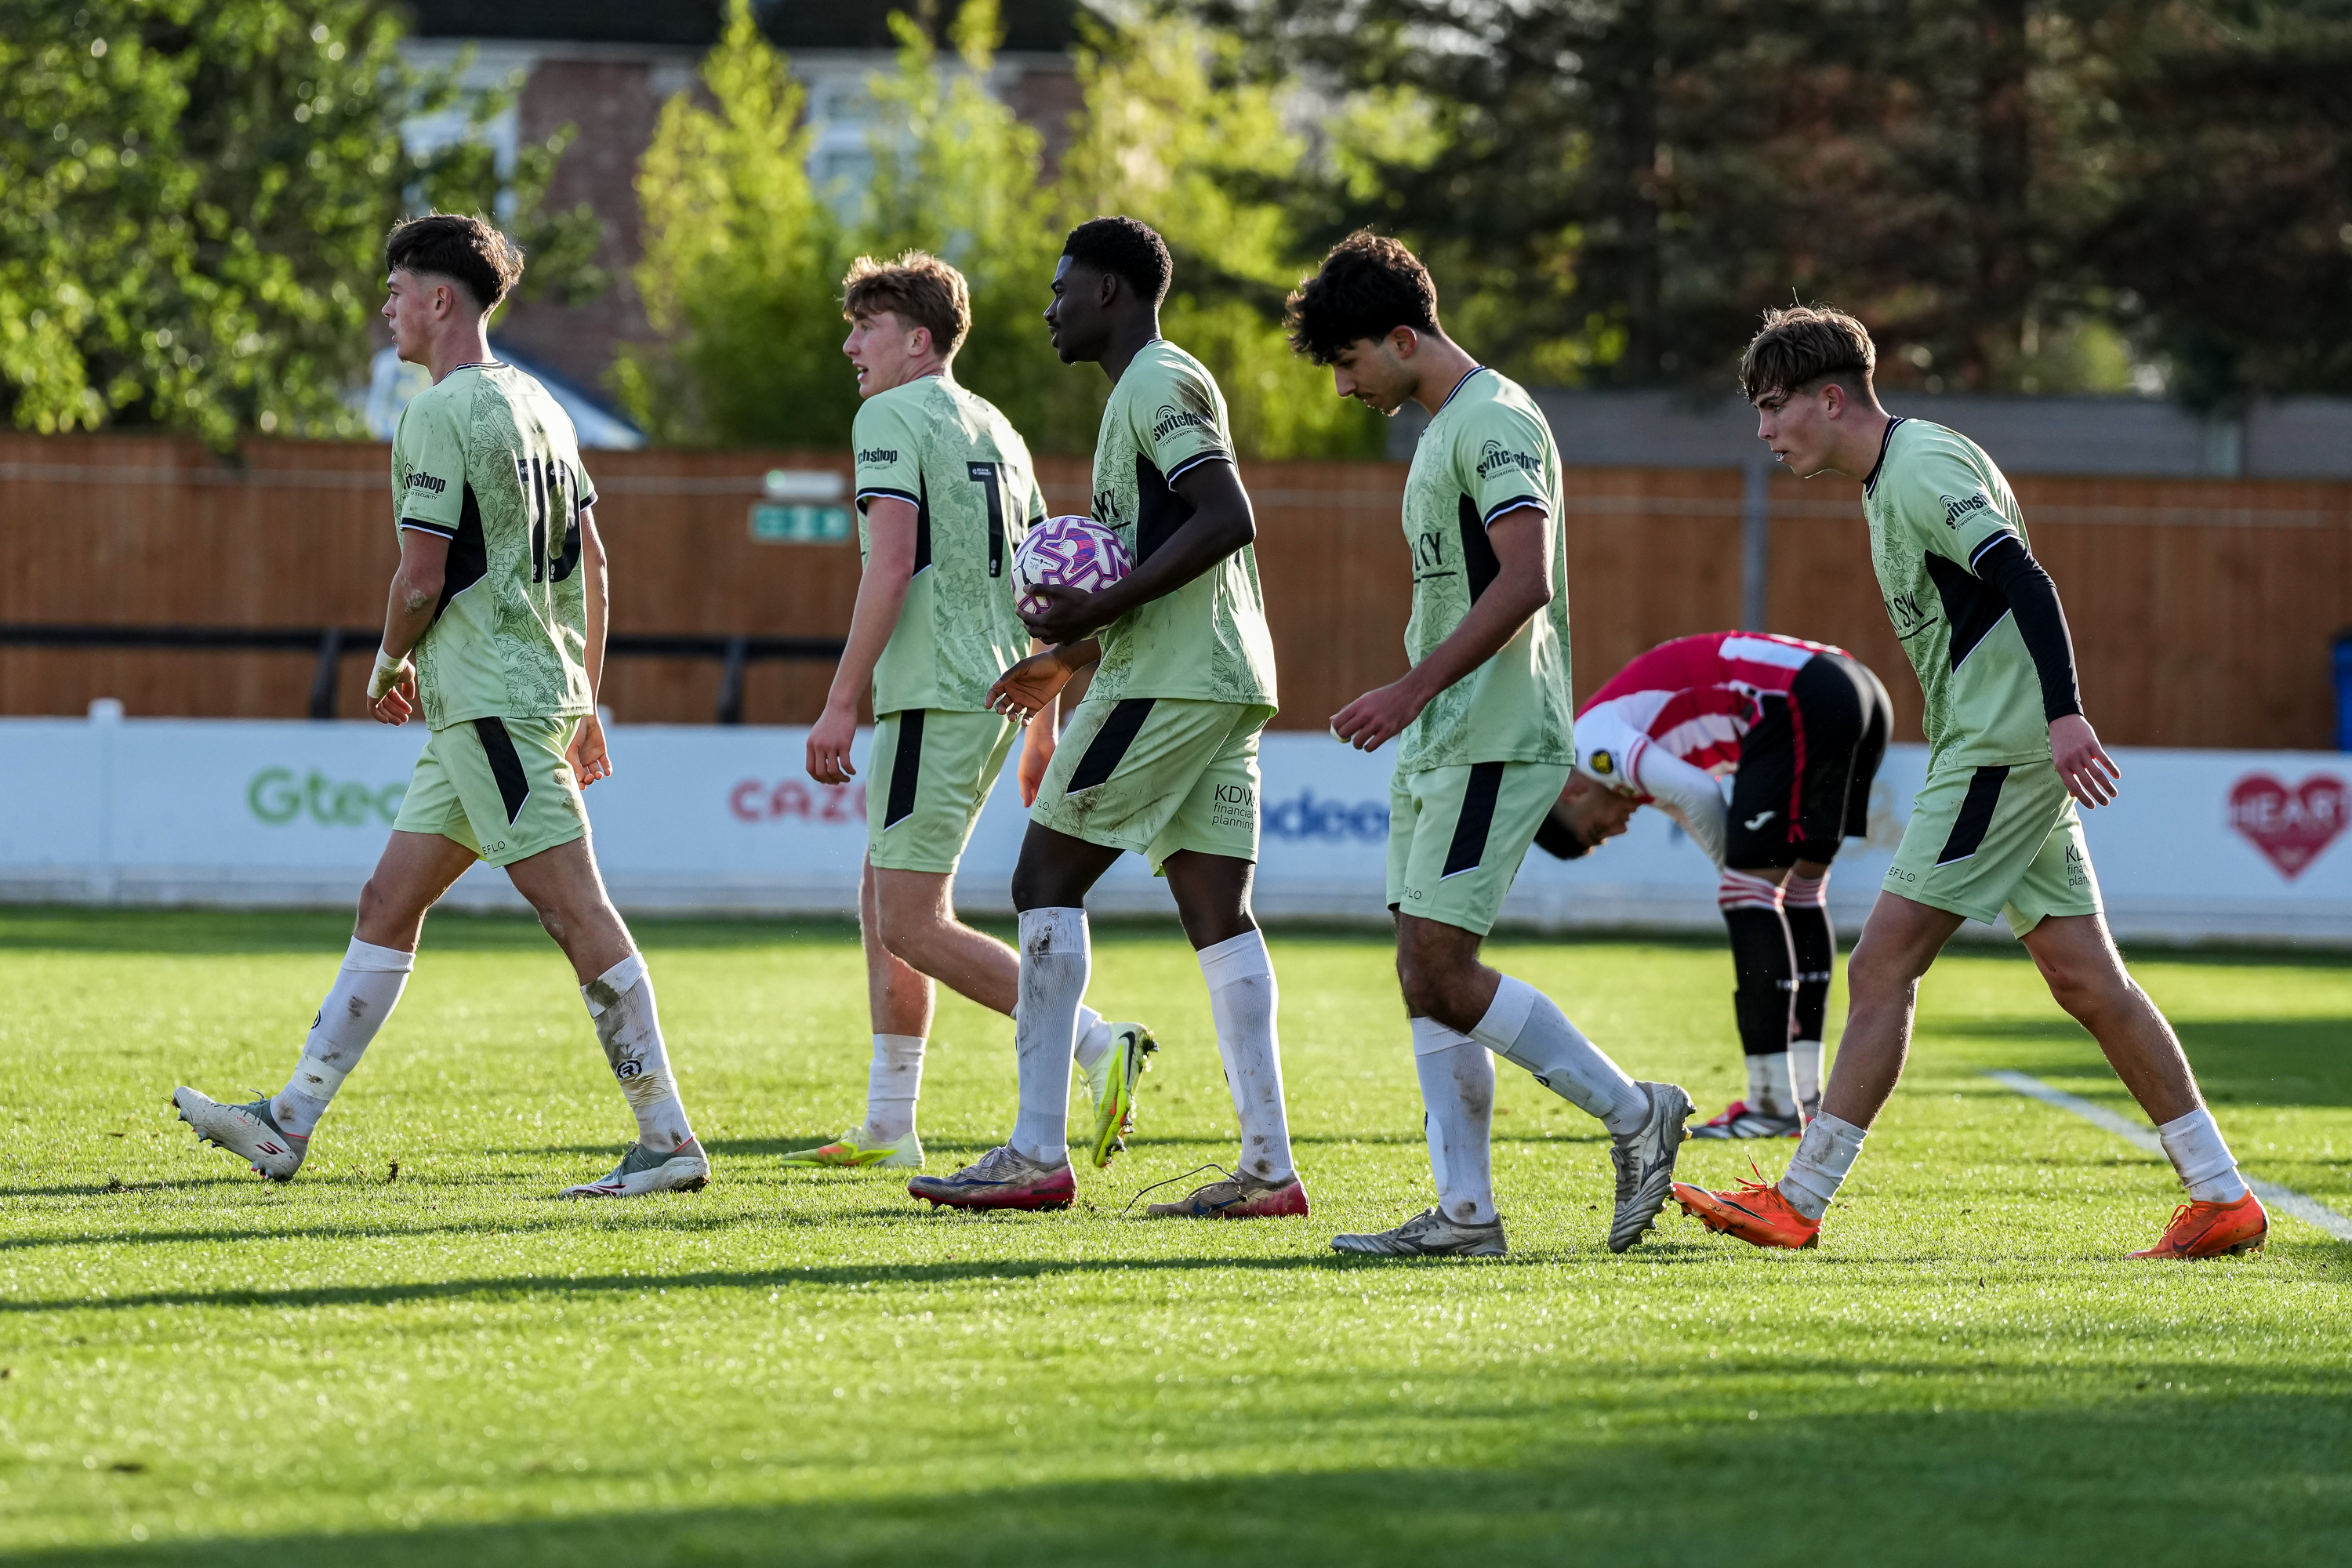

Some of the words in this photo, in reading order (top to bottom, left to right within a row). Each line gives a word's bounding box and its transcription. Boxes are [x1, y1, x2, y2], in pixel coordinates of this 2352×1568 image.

[1153, 412, 1201, 441] switchs
[858, 448, 898, 464] chshop
[1486, 468, 1515, 481] ETWORKING
[247, 766, 407, 826] Gtec
[729, 779, 867, 823] CAZ
[1214, 802, 1254, 818] financial
[1212, 814, 1254, 833] planning
[482, 840, 506, 855] EFLO
[1889, 866, 1915, 882] EFLO
